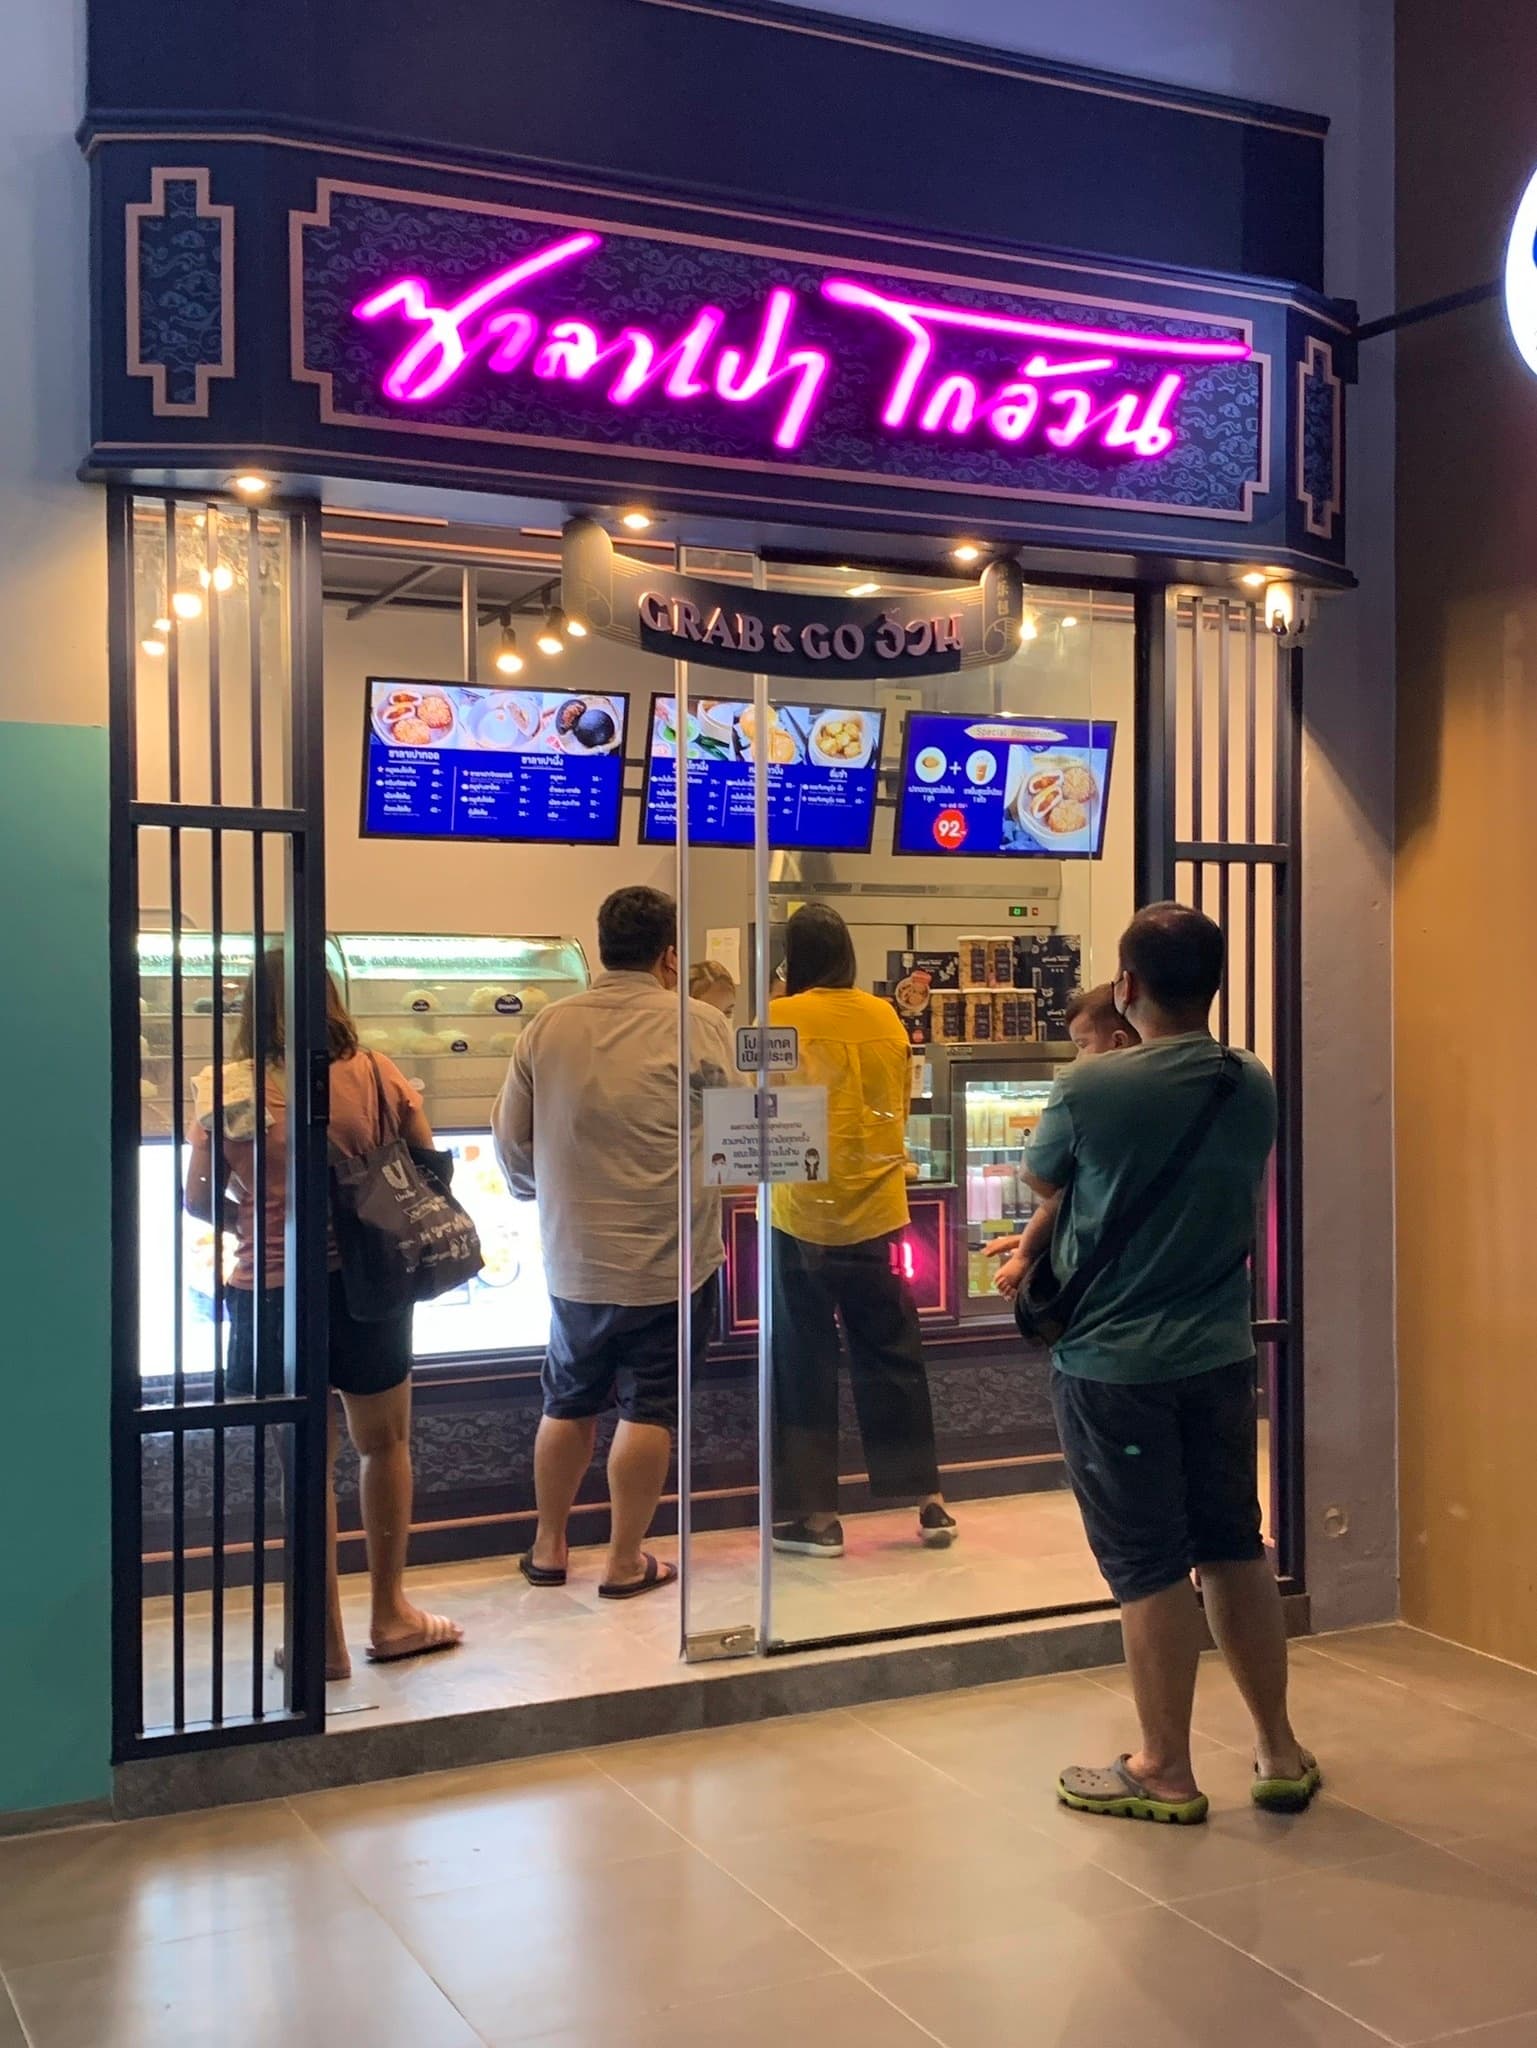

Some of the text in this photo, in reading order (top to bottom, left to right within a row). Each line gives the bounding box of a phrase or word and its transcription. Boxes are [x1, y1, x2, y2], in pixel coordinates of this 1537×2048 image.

[638, 590, 765, 653] GRAB
[773, 623, 793, 653] &
[800, 621, 865, 660] GO
